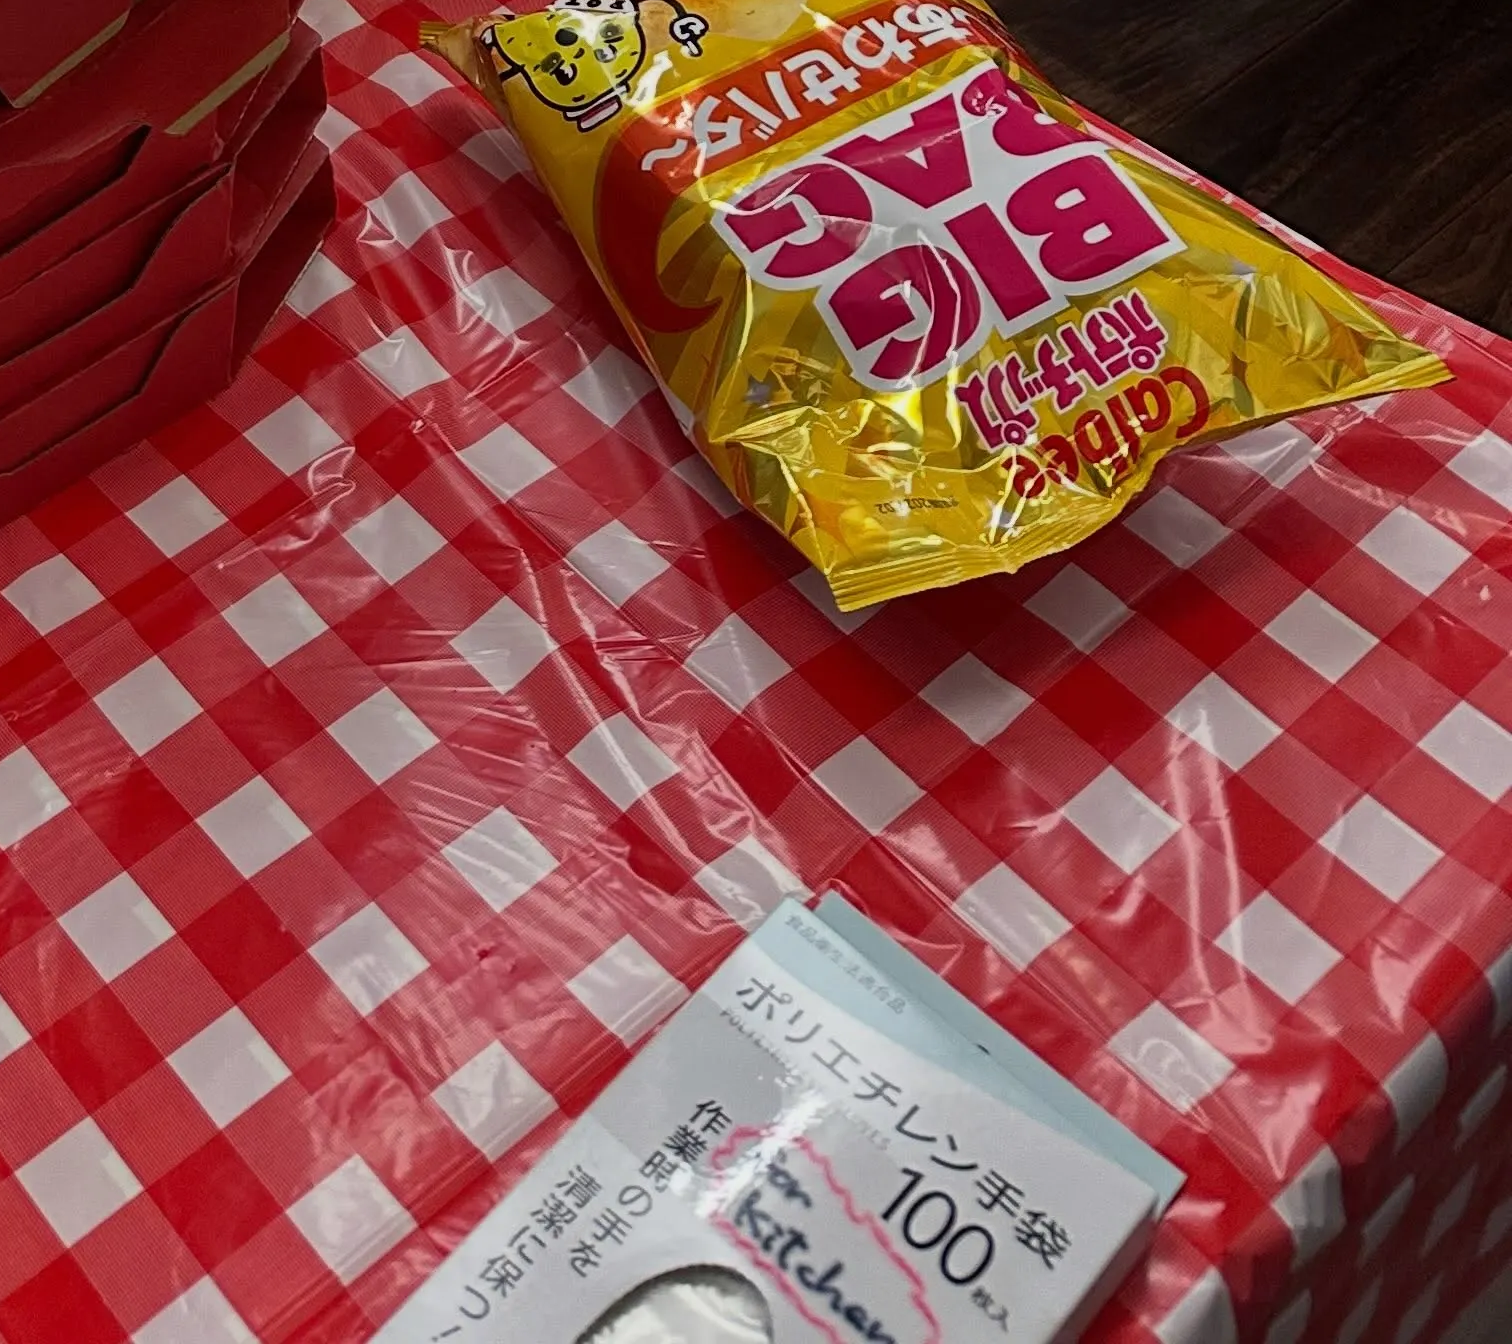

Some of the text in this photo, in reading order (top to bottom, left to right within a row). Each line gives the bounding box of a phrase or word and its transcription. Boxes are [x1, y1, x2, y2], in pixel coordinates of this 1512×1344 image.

[725, 68, 1090, 279] BAG
[828, 154, 1170, 380] BIG
[955, 288, 1168, 452] ポテトチップス
[1002, 366, 1209, 498] Calbee
[736, 978, 1072, 1270] ポリエチレン手袋
